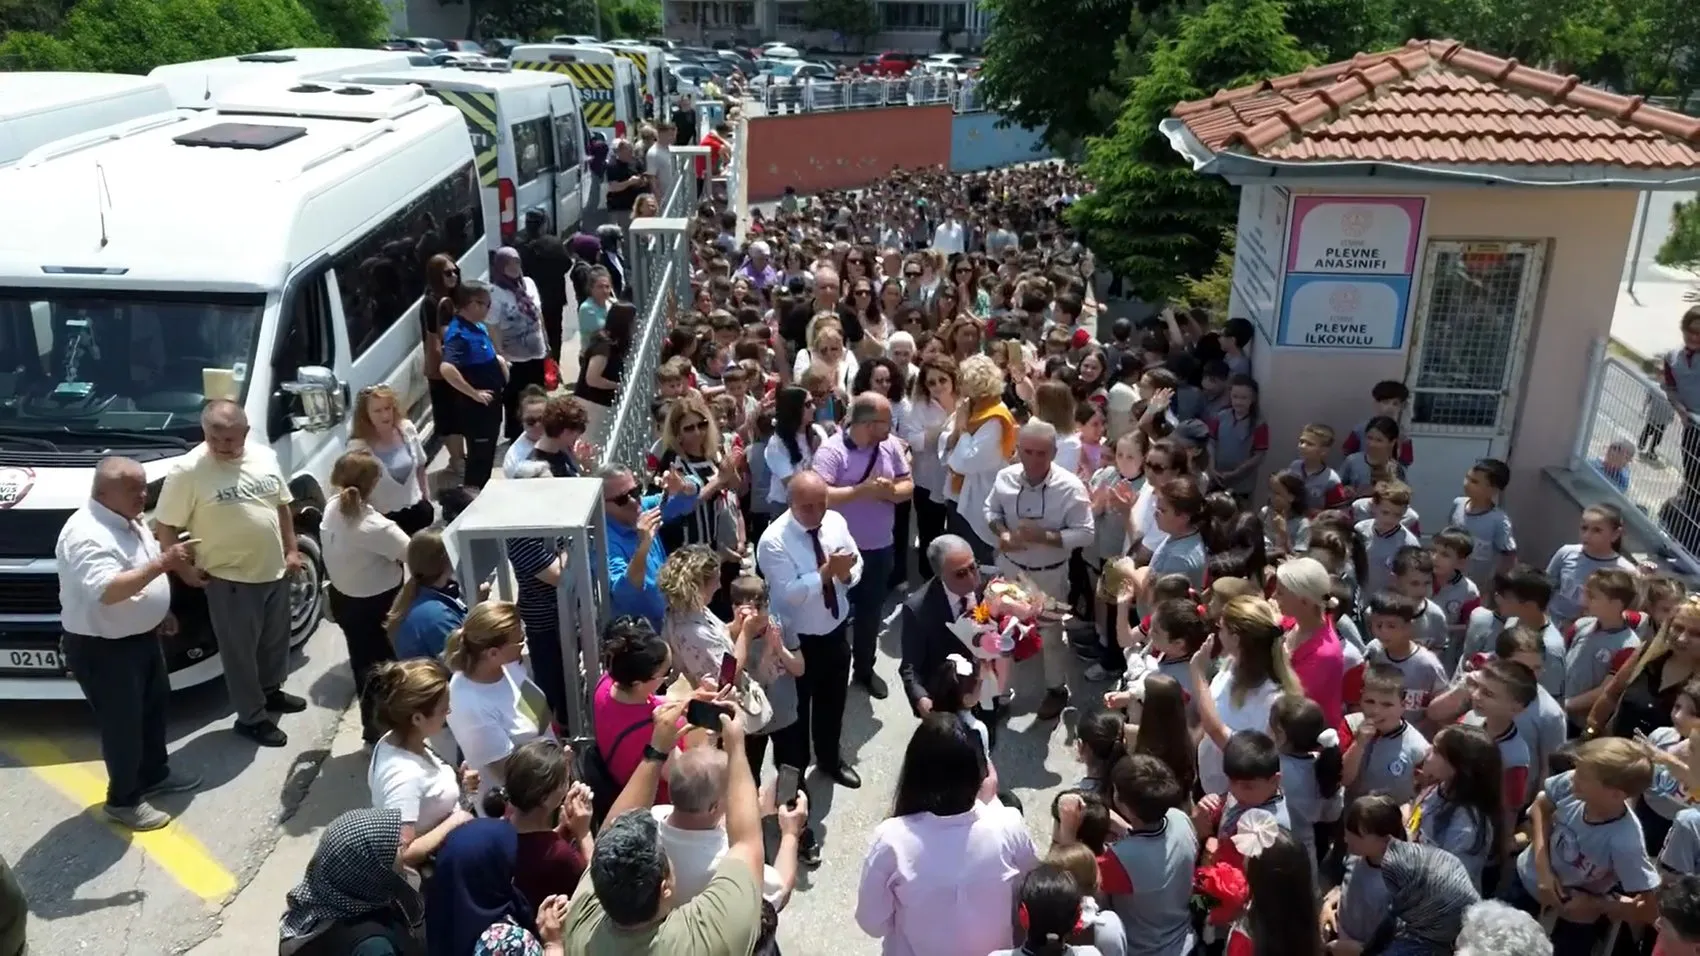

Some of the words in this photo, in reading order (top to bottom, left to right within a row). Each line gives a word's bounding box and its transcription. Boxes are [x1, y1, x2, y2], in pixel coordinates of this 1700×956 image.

[1326, 247, 1380, 259] PLEVNE
[1314, 258, 1387, 269] ANASINIFI
[1315, 322, 1368, 333] PLEVNE
[1305, 332, 1374, 345] İLKOKULU
[10, 651, 56, 666] 0214
